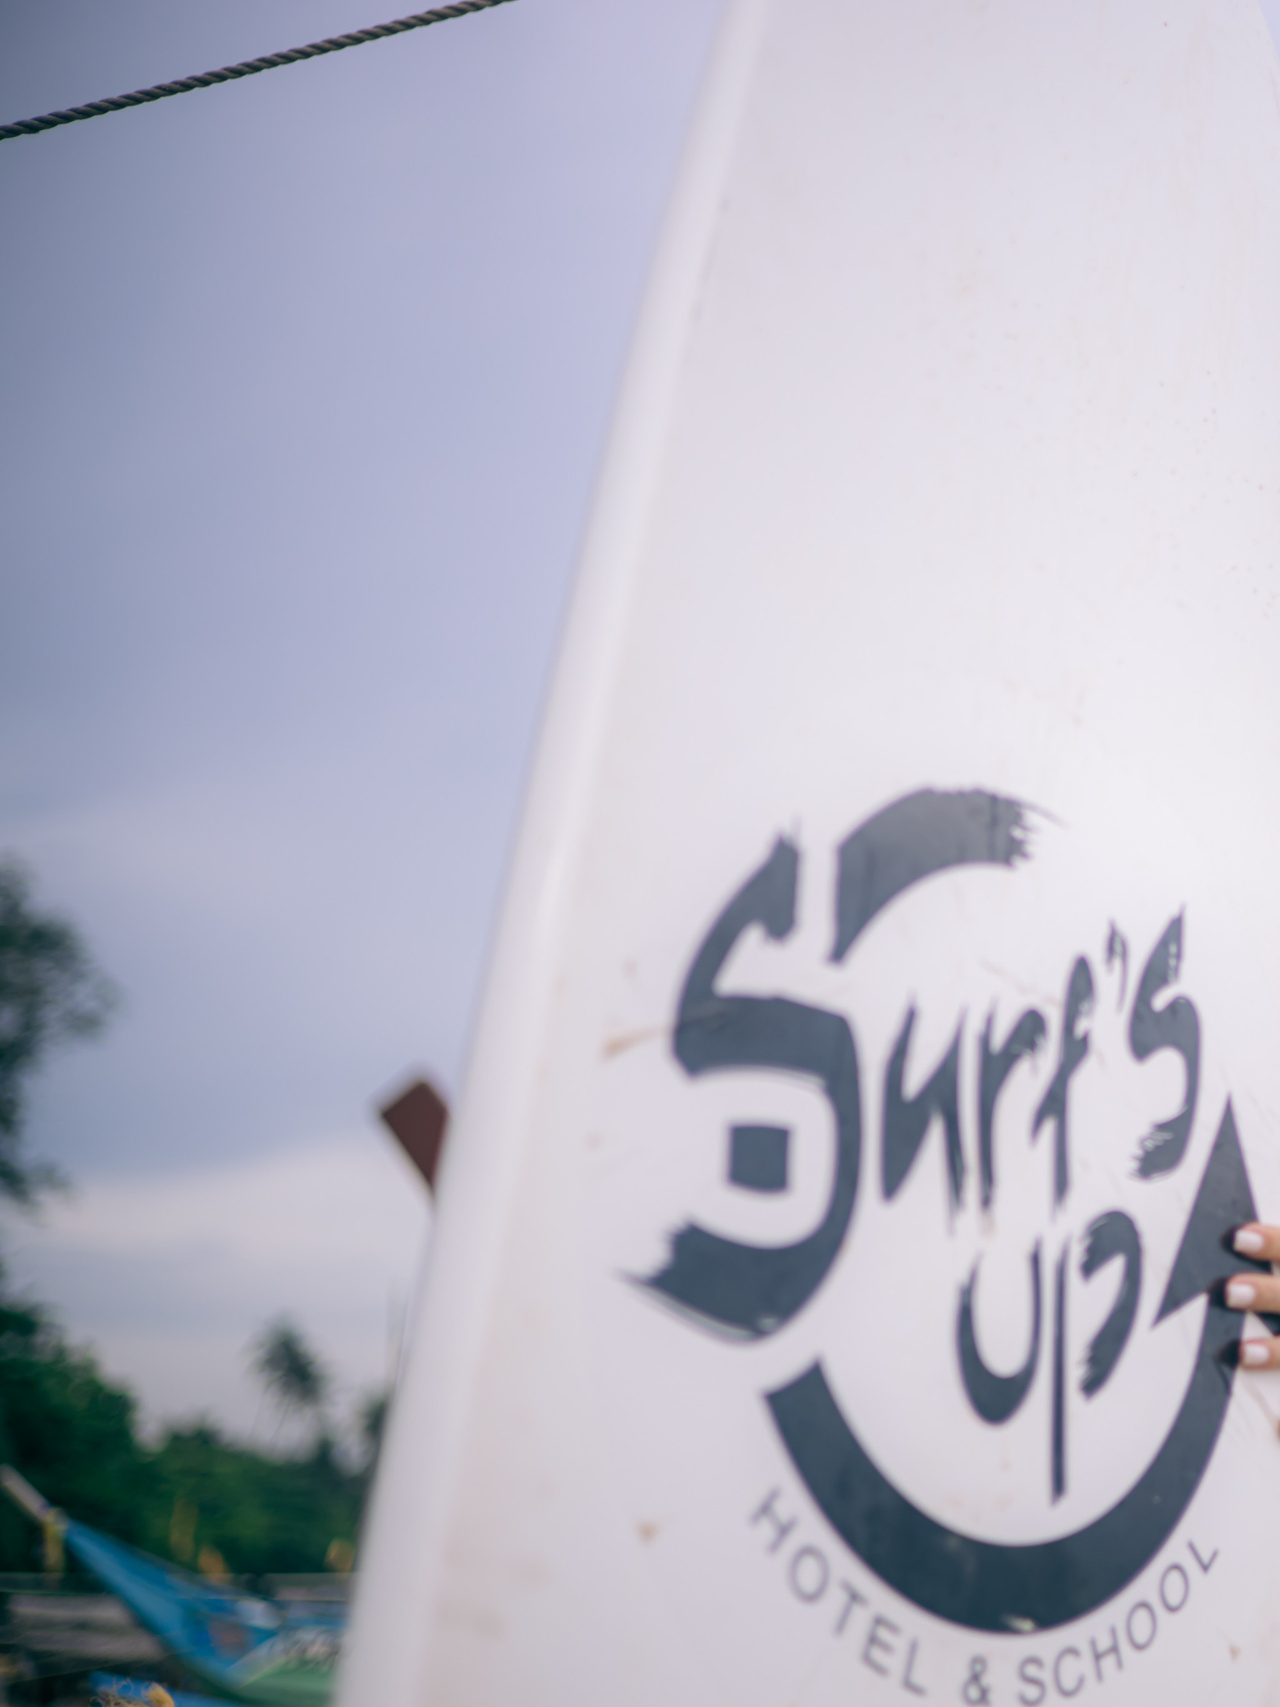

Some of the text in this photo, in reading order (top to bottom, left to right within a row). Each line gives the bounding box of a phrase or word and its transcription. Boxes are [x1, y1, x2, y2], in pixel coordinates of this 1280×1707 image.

[616, 820, 1202, 1344] Surf's
[750, 1487, 1219, 1706] HOTEL & SCHOOL
